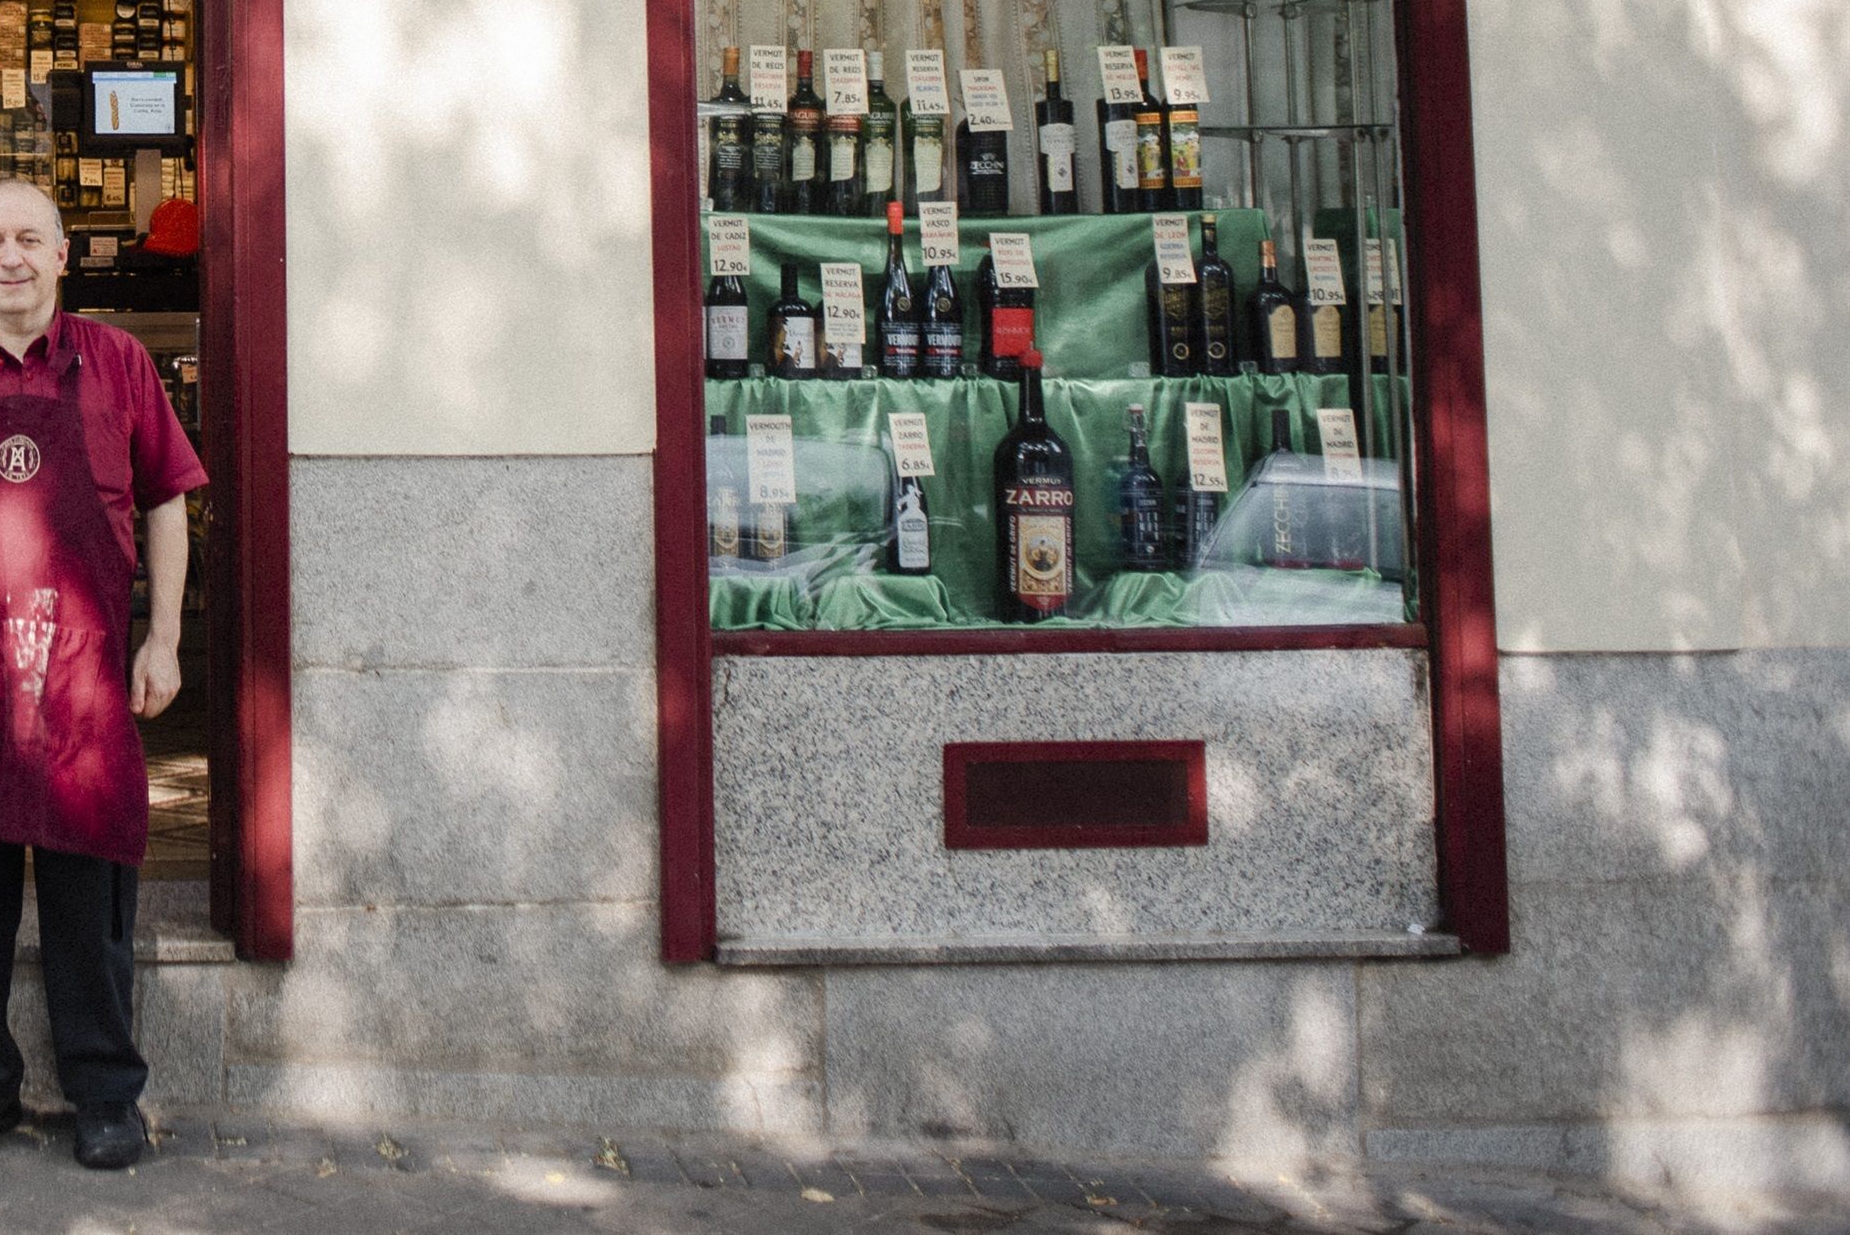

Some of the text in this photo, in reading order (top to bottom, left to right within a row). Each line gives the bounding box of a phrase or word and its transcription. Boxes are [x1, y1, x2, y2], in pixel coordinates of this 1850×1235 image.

[753, 49, 783, 57] VERMUT
[829, 54, 859, 62] VERMUT
[910, 54, 940, 62] VERMUT
[752, 62, 762, 70] DE
[830, 66, 839, 74] DE
[712, 219, 743, 227] VERMUT
[1154, 218, 1186, 226] VERMUT
[711, 232, 721, 240] DE
[825, 267, 856, 275] VERMUT
[1022, 476, 1062, 485] VERMUT
[1005, 488, 1074, 506] ZARRO
